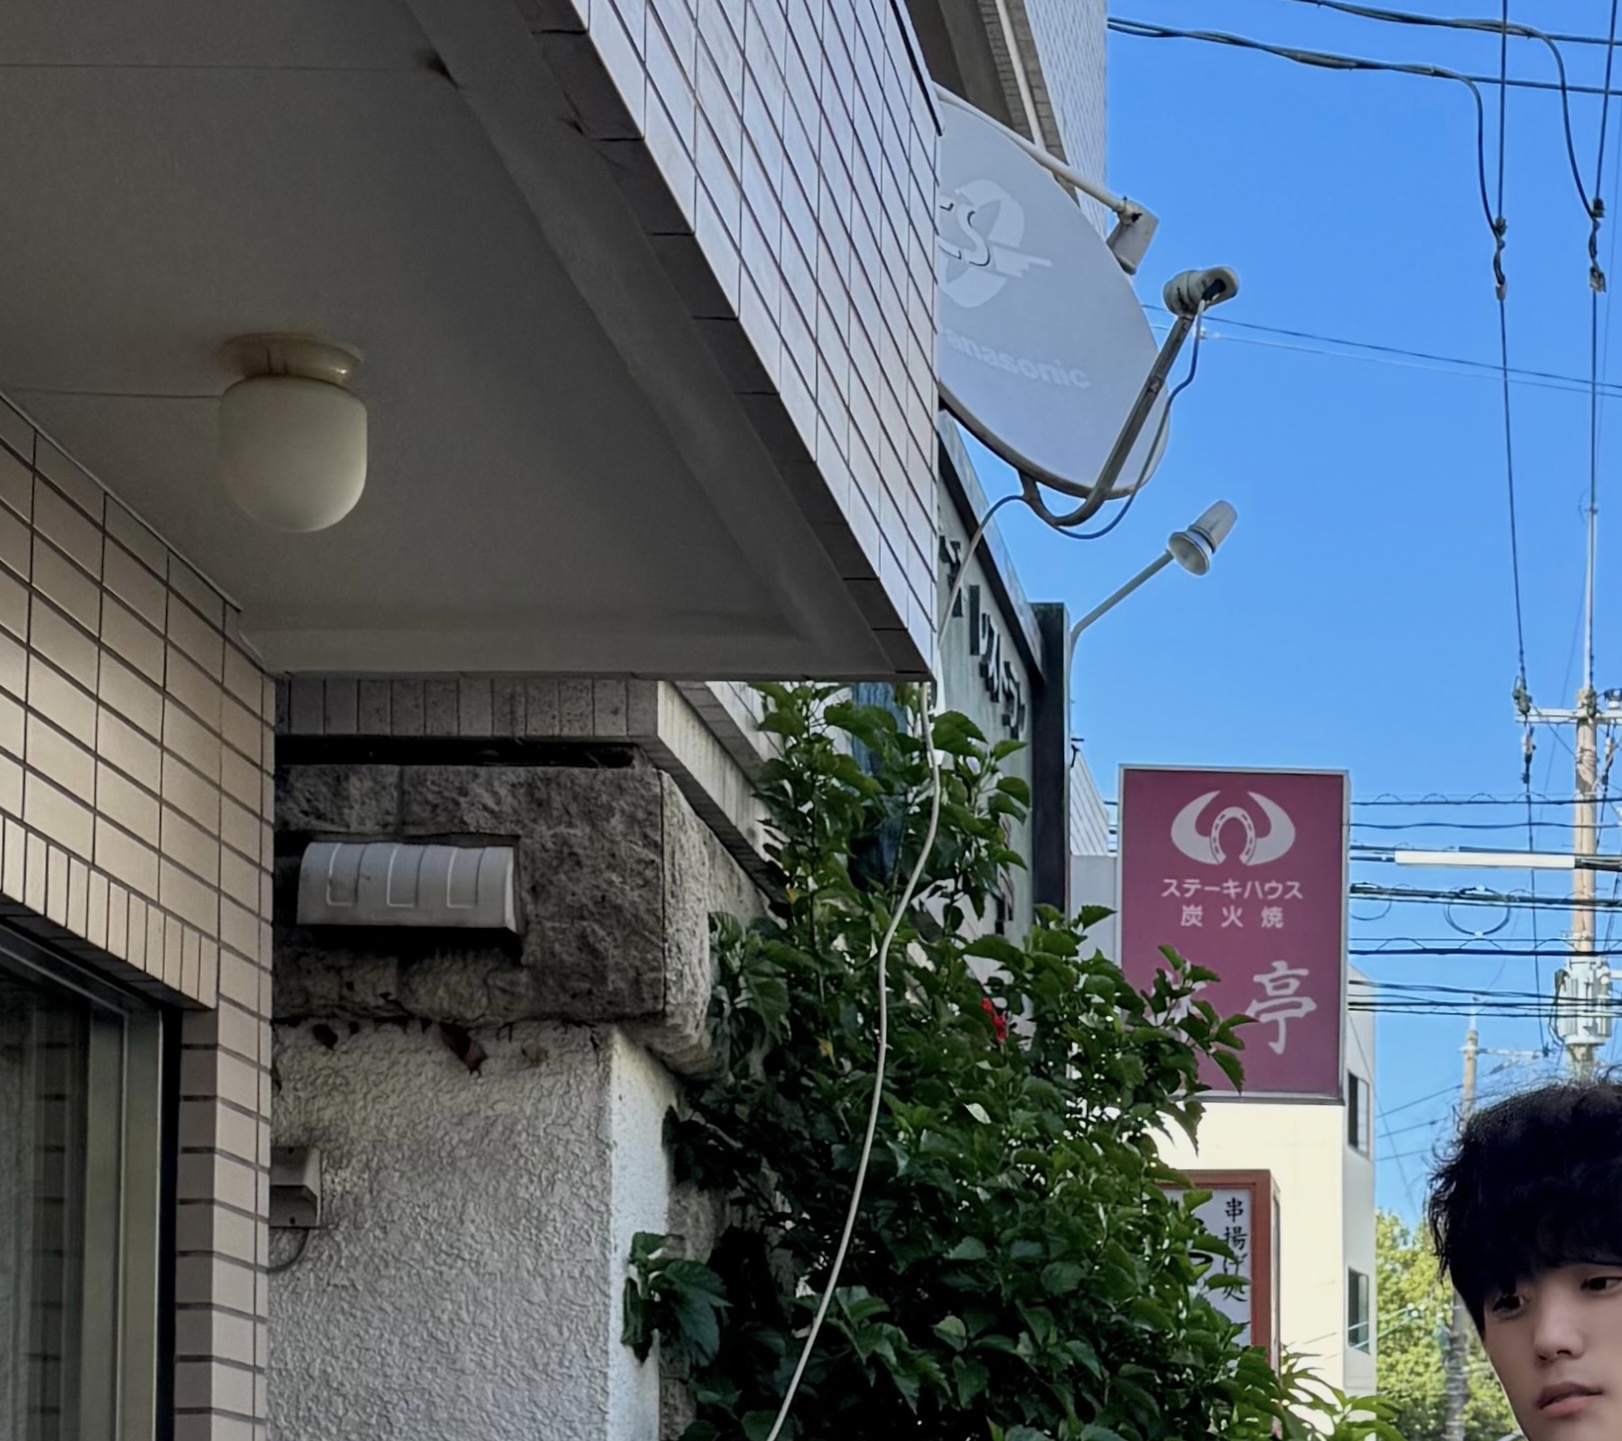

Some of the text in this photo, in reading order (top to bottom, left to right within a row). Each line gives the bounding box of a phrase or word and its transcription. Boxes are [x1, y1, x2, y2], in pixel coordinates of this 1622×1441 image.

[939, 325, 1091, 389] anasonic
[1161, 879, 1303, 899] ステーキハウス
[1180, 904, 1284, 929] 炭火焼
